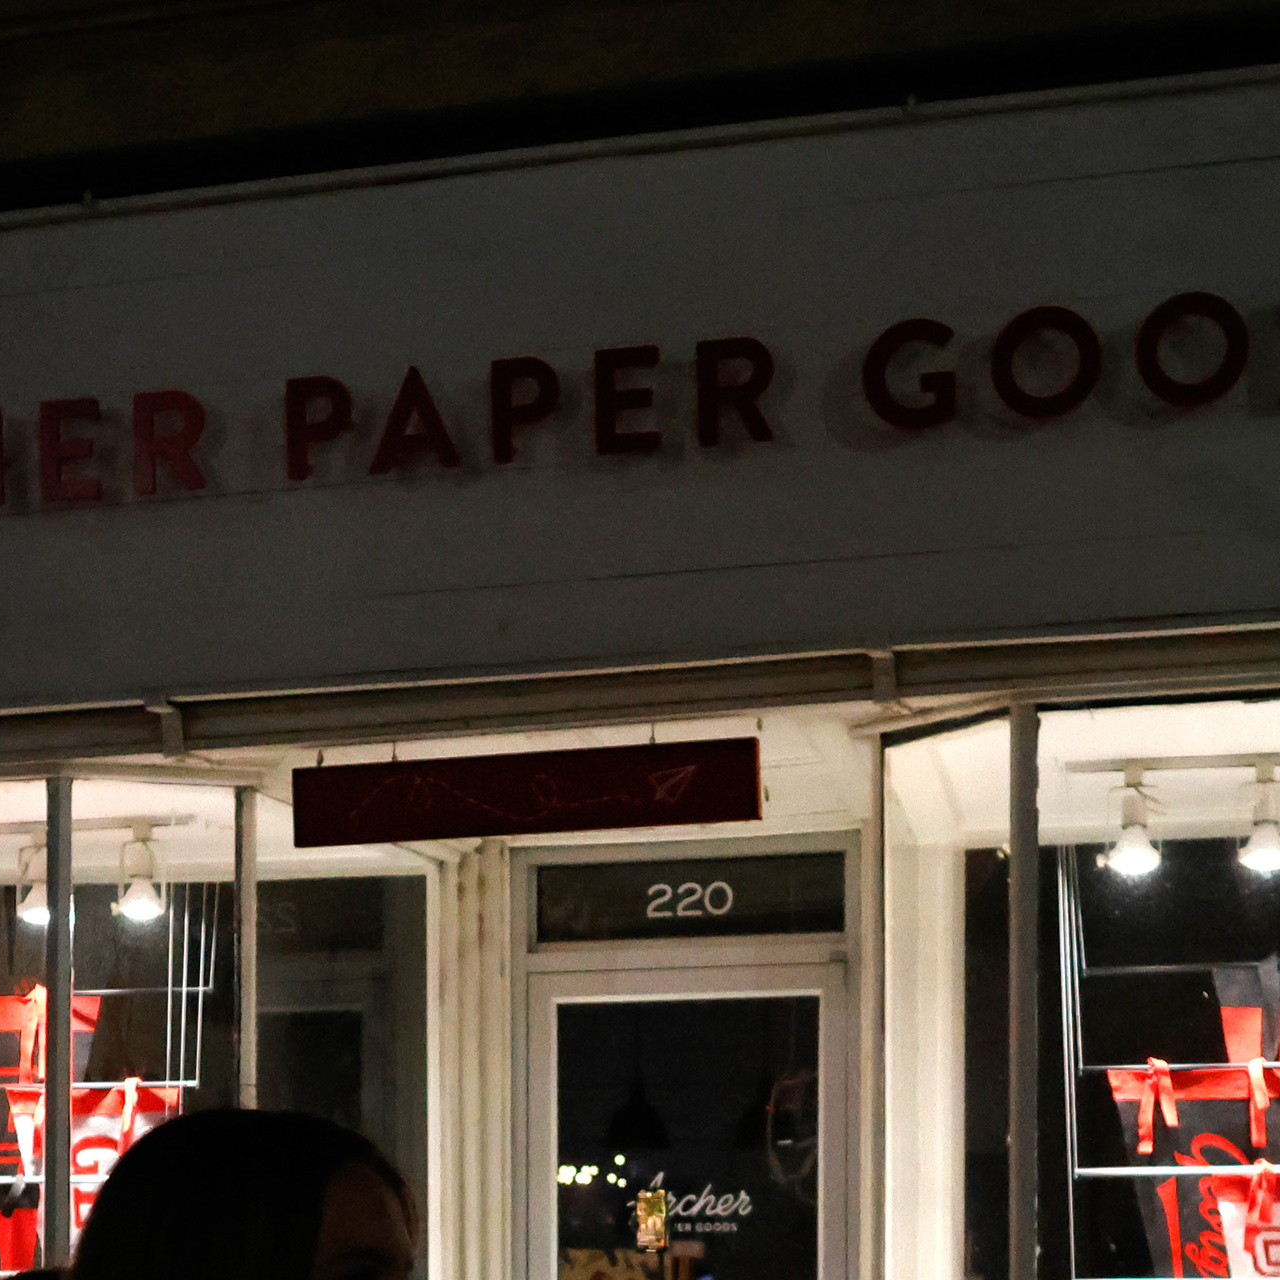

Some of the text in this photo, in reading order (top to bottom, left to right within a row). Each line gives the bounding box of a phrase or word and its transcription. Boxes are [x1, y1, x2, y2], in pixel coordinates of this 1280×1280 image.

[284, 336, 774, 480] PAPER
[646, 881, 733, 918] 220
[626, 1171, 753, 1217] rcher
[695, 1222, 738, 1233] GOODS
